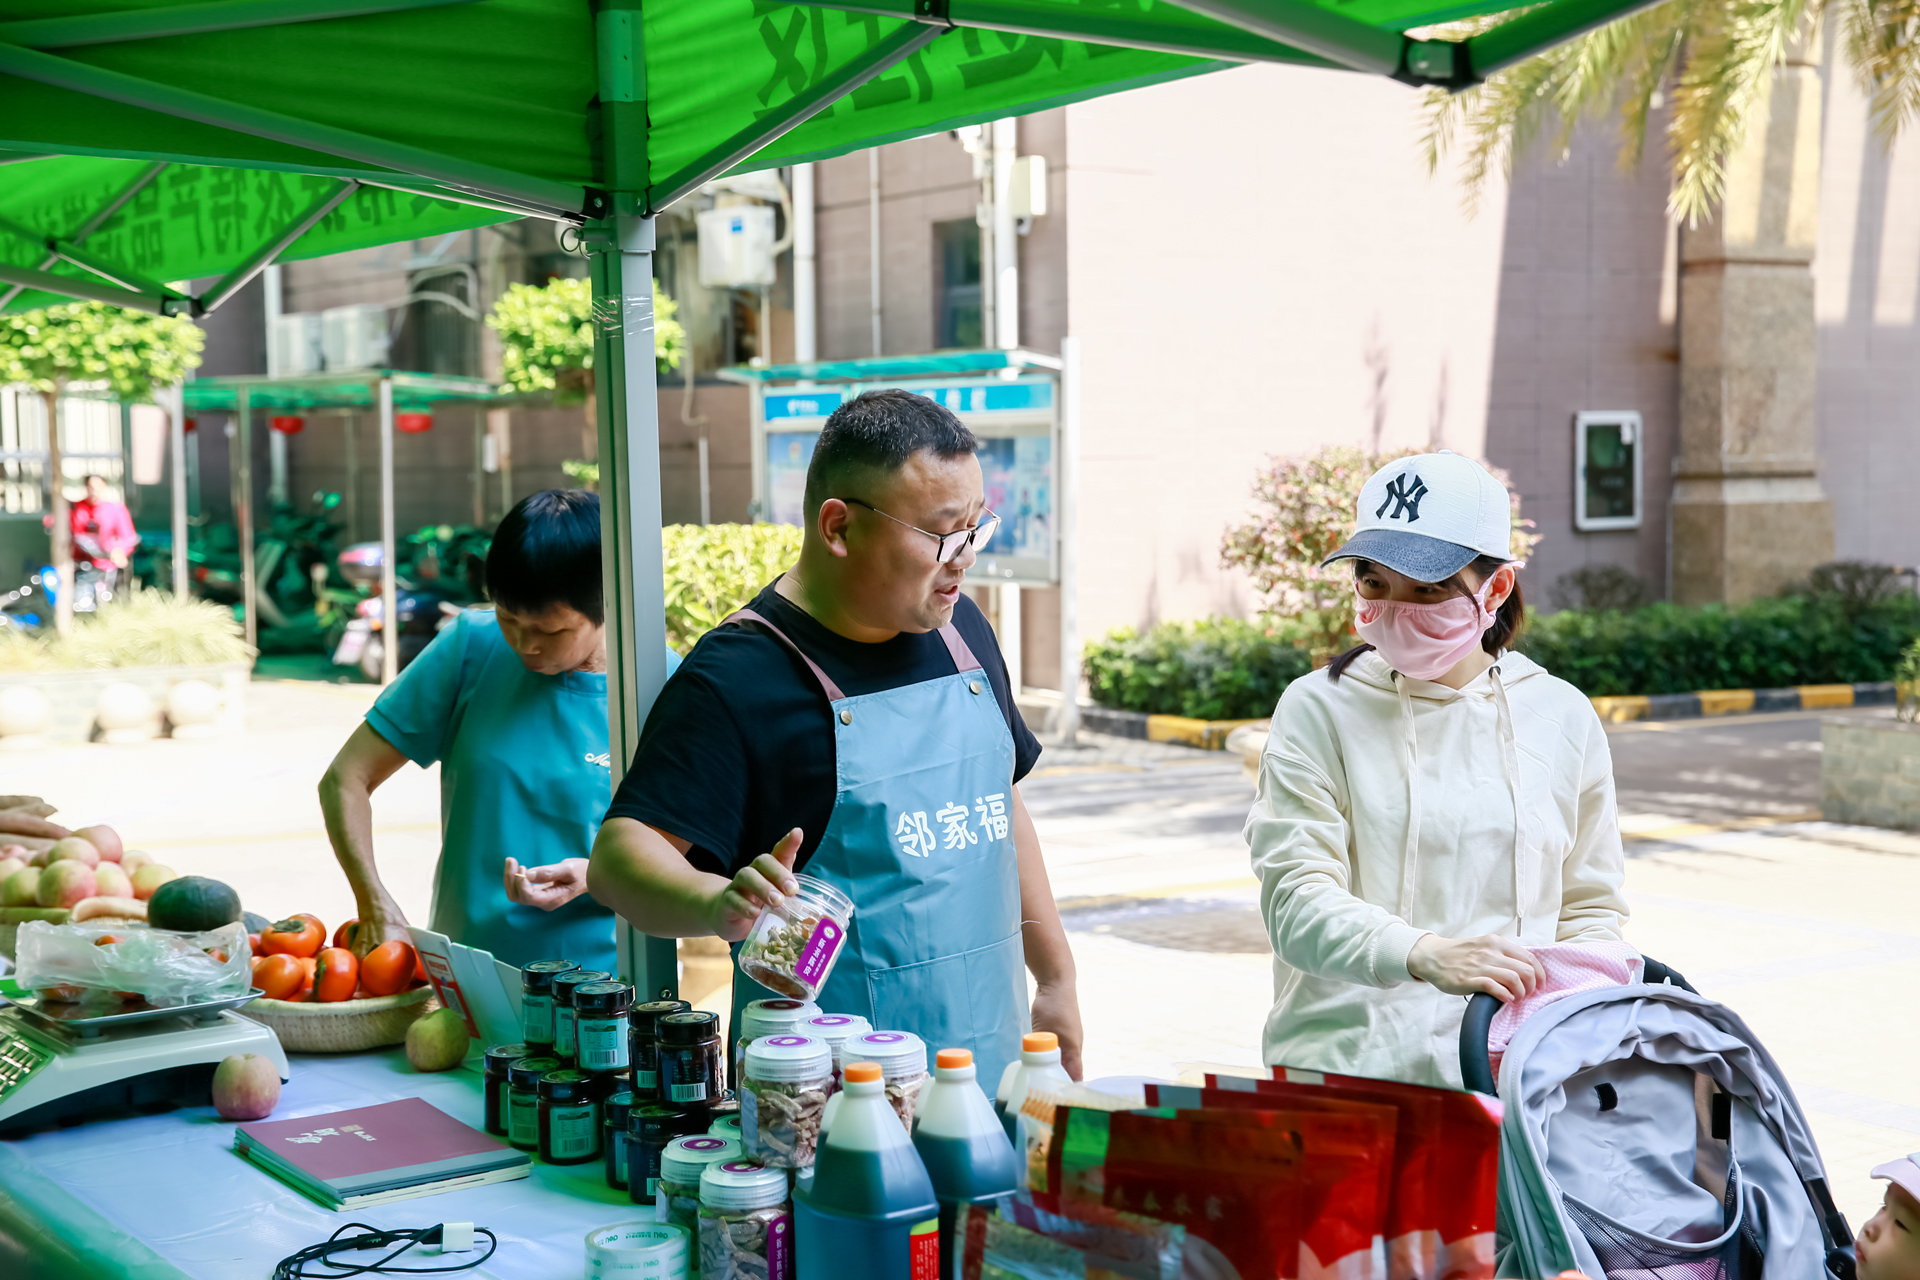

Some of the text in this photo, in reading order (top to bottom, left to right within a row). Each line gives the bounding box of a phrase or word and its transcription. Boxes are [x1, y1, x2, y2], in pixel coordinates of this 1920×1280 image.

[1376, 473, 1429, 523] NY
[895, 793, 1008, 858] 邻家福
